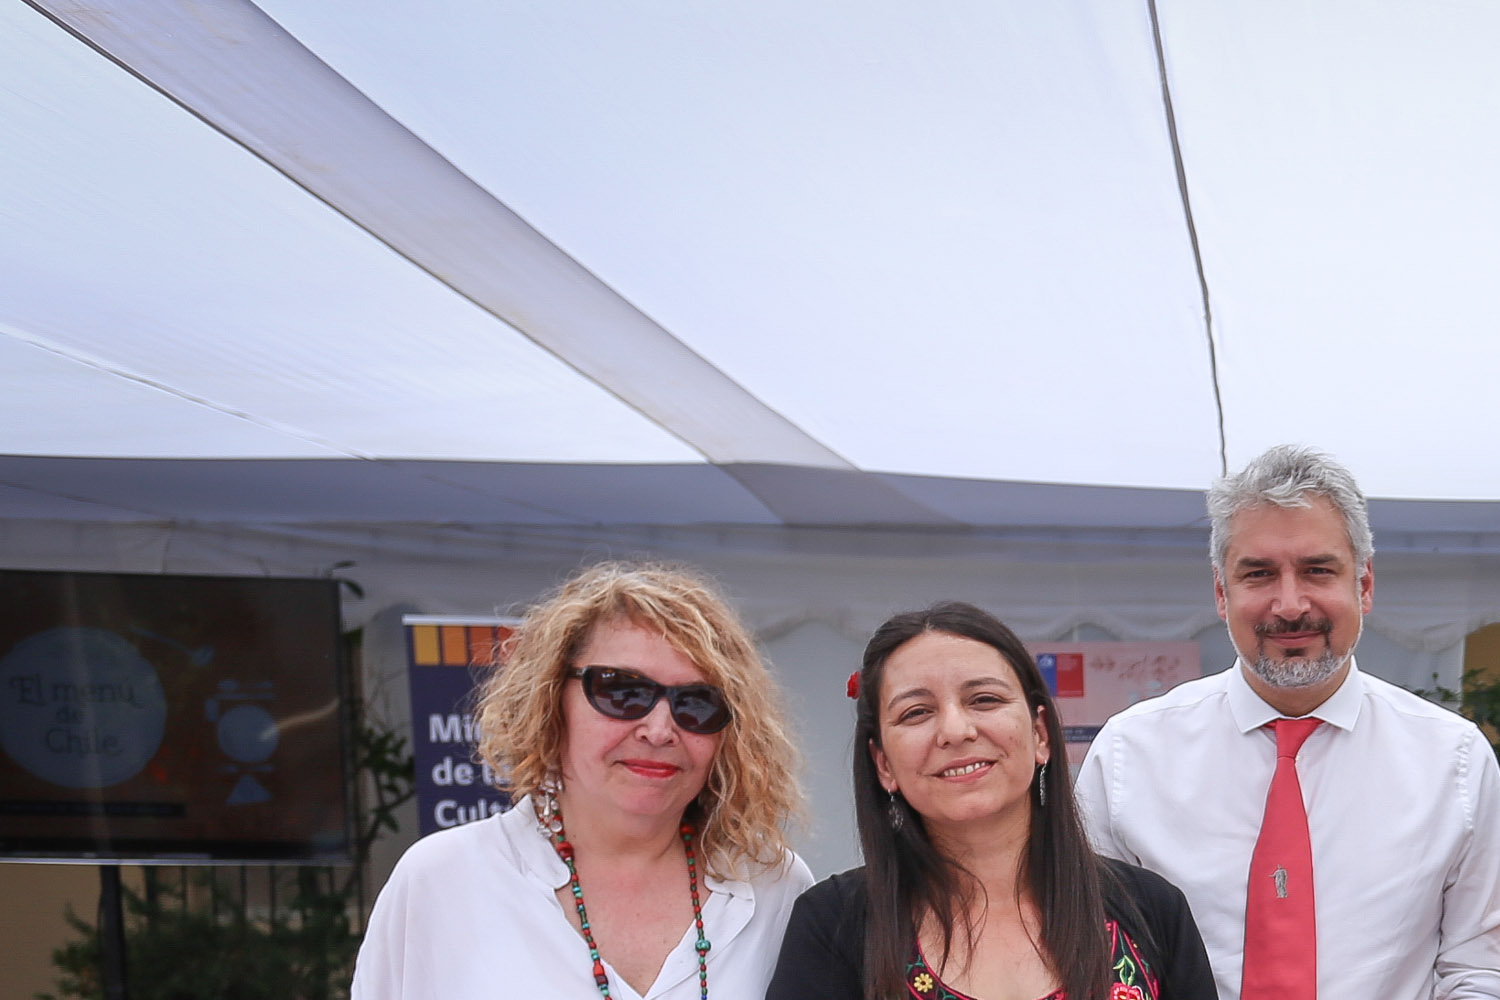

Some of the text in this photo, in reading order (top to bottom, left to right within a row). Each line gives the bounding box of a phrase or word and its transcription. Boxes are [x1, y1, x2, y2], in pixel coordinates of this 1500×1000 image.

[8, 673, 47, 706] El
[56, 703, 83, 724] de
[46, 727, 126, 757] Chile
[431, 757, 474, 786] de
[434, 798, 511, 828] Cult
